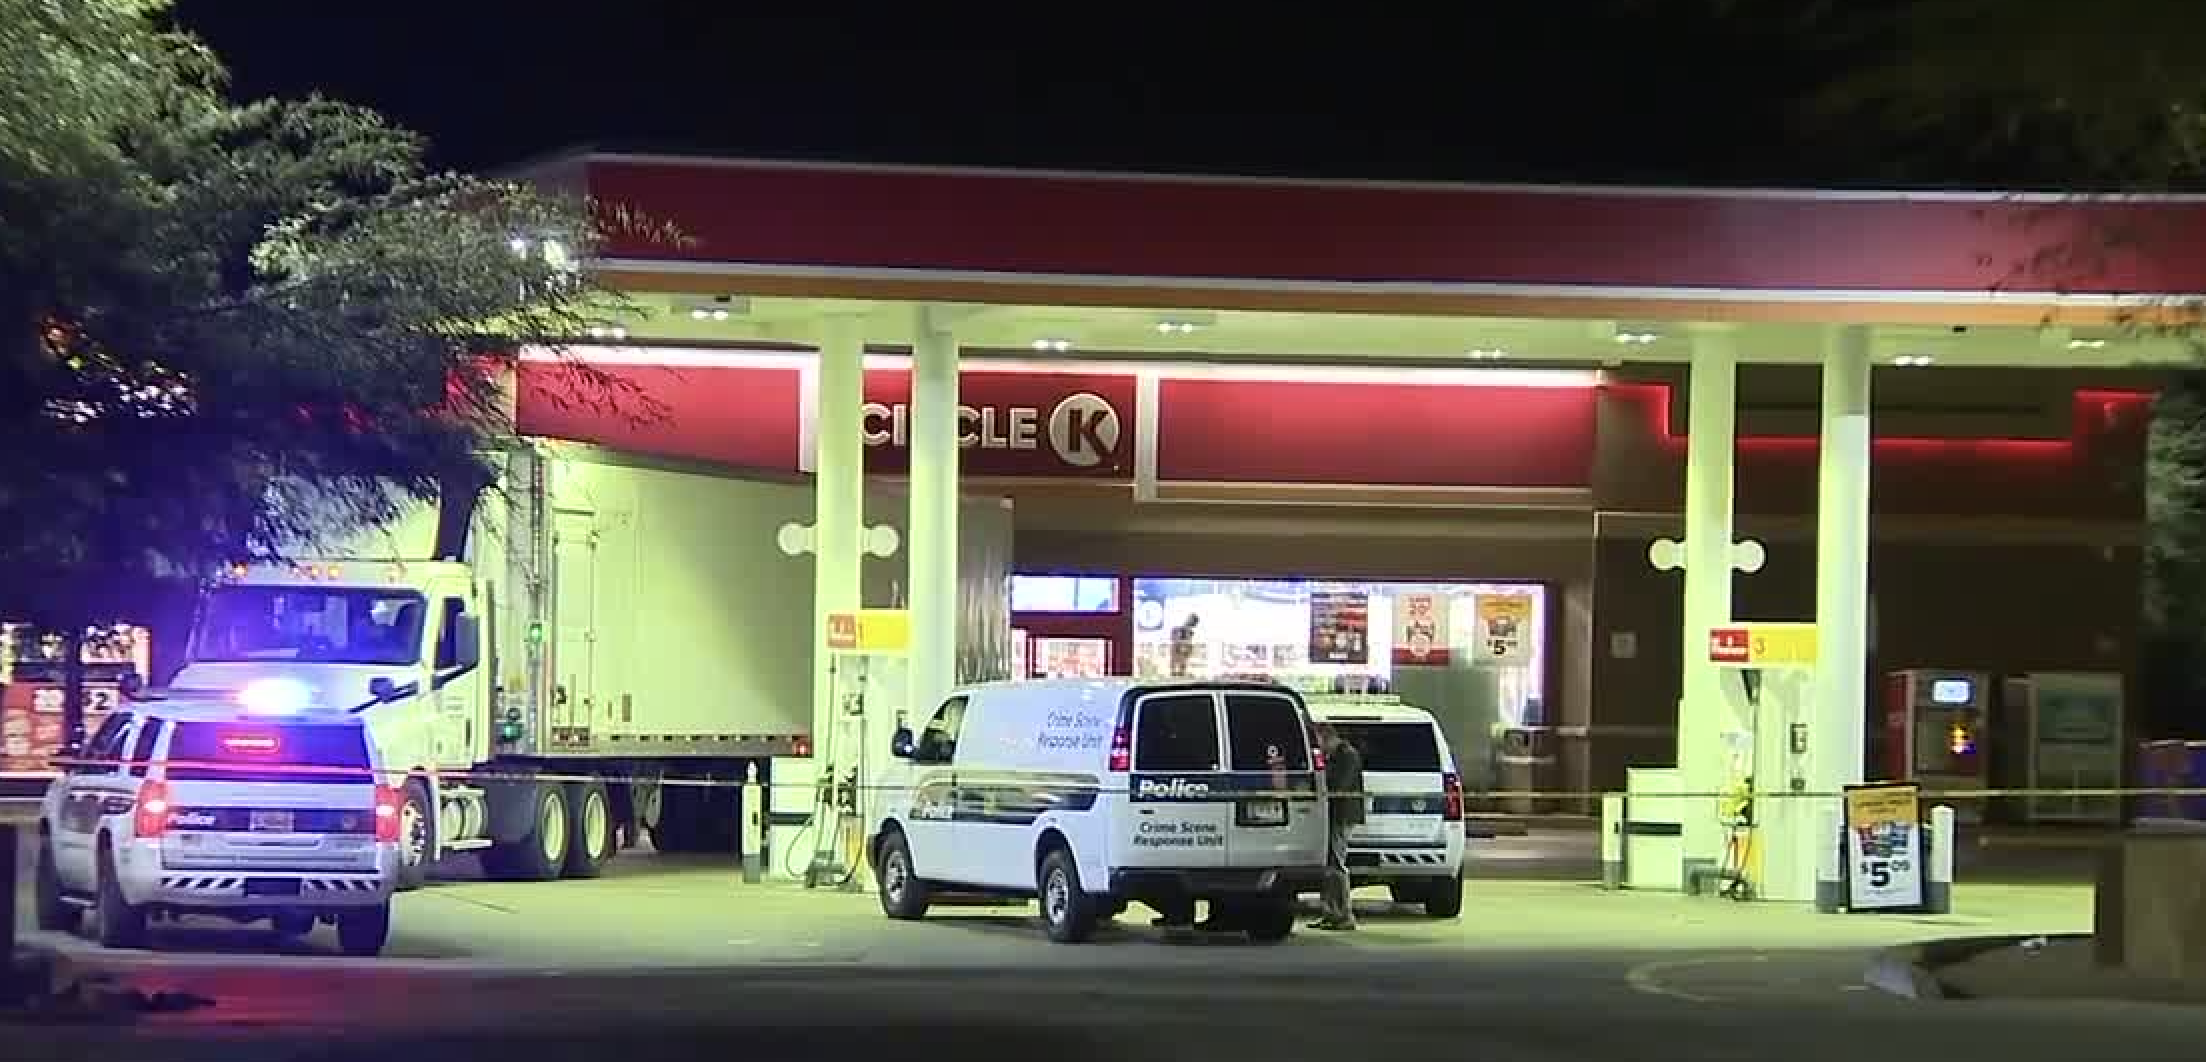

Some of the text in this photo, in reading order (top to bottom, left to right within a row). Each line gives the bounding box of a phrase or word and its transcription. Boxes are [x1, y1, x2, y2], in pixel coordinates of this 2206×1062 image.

[861, 402, 1116, 458] CICLE K
[1138, 777, 1209, 799] Police
[168, 810, 217, 827] Police
[1139, 821, 1217, 834] Crime Scene
[1133, 833, 1223, 848] Response Unit
